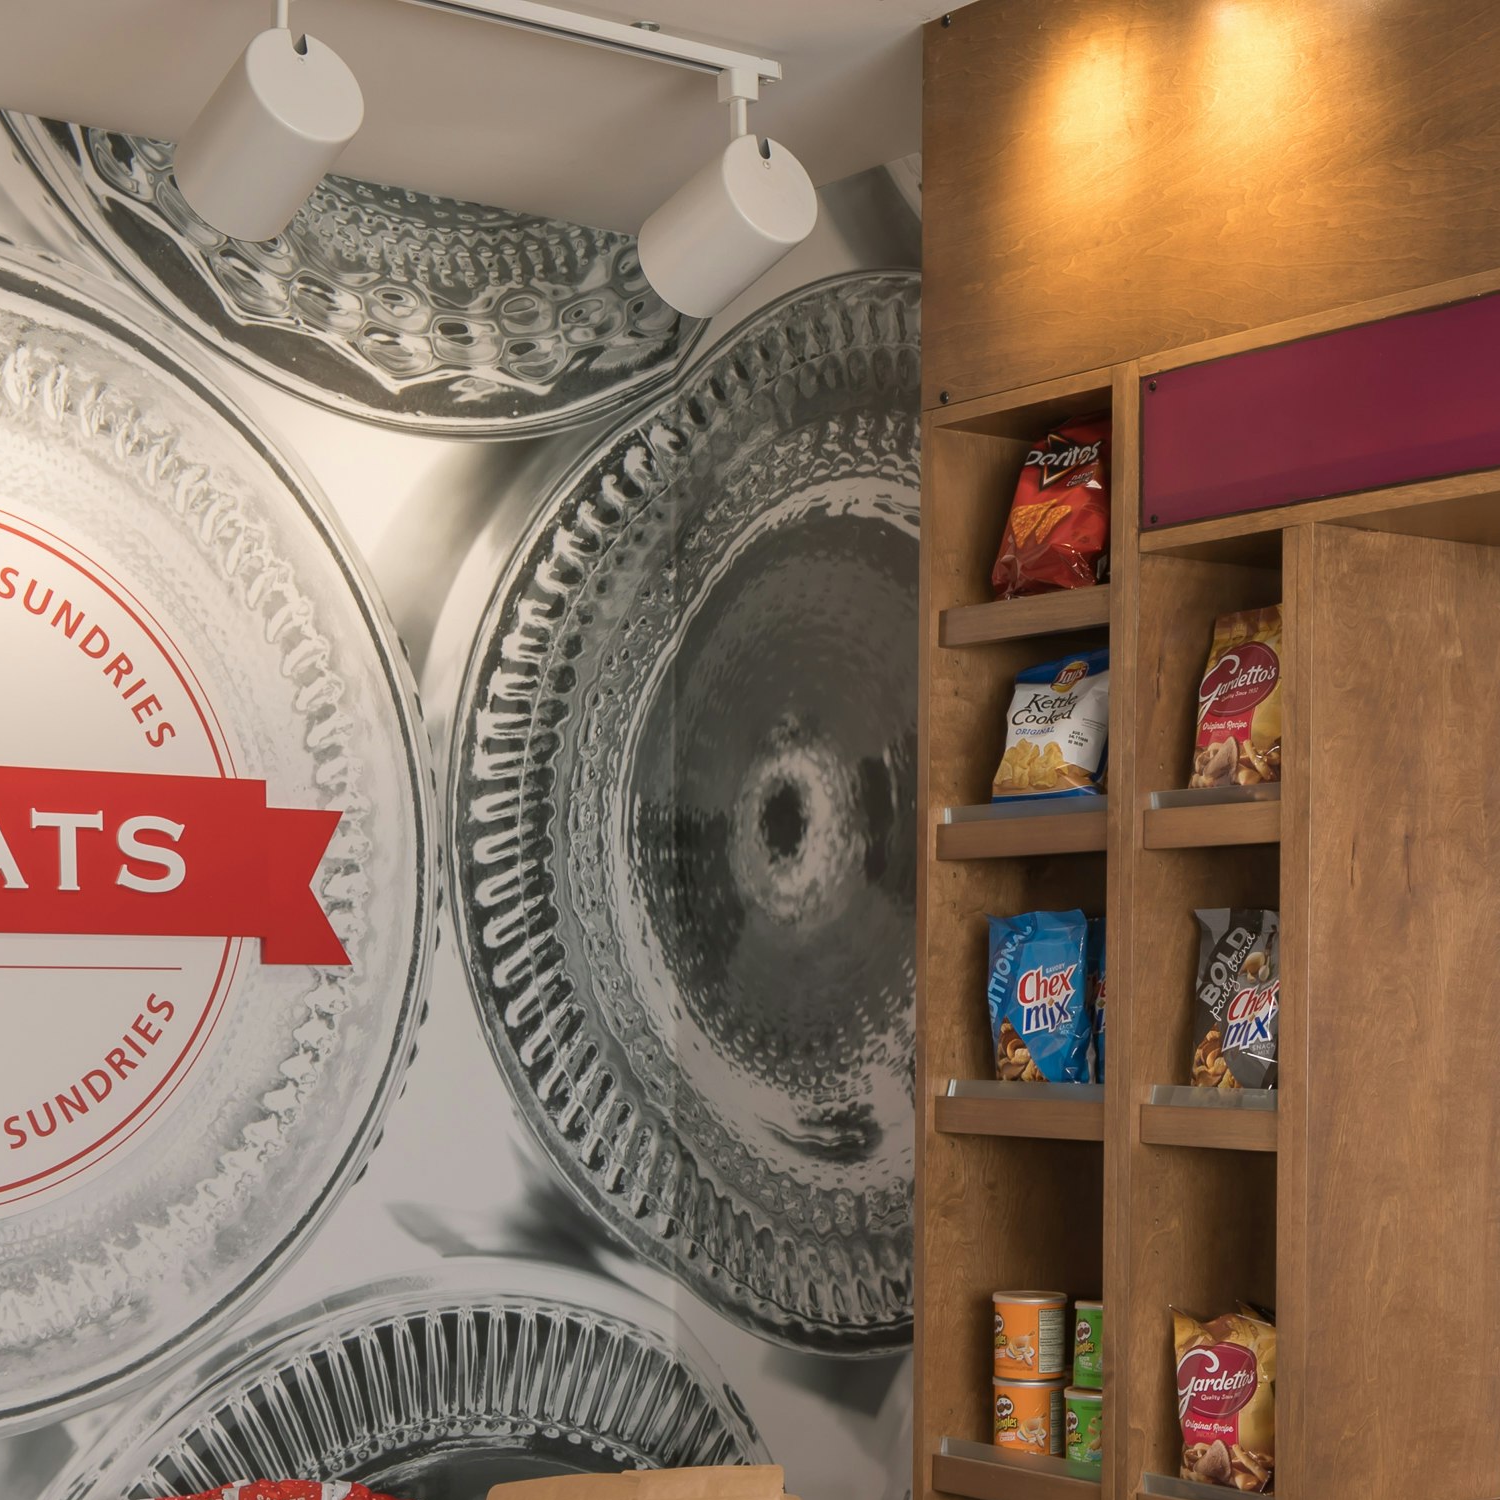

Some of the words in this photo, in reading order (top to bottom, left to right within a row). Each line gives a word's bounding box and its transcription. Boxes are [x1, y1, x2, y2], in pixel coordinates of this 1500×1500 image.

[1025, 441, 1102, 466] Doritos
[1025, 692, 1077, 712] Kettle
[1197, 655, 1276, 725] Gardetto's
[1012, 703, 1076, 725] Cooked
[1016, 727, 1055, 735] ORIGINAL
[1019, 966, 1077, 1003] Chex
[1200, 927, 1249, 1006] BOLD
[1229, 980, 1280, 1021] Chex
[3, 992, 175, 1150] SUNDRIES
[1177, 1349, 1254, 1420] Gardetto's
[1185, 1420, 1212, 1431] Original
